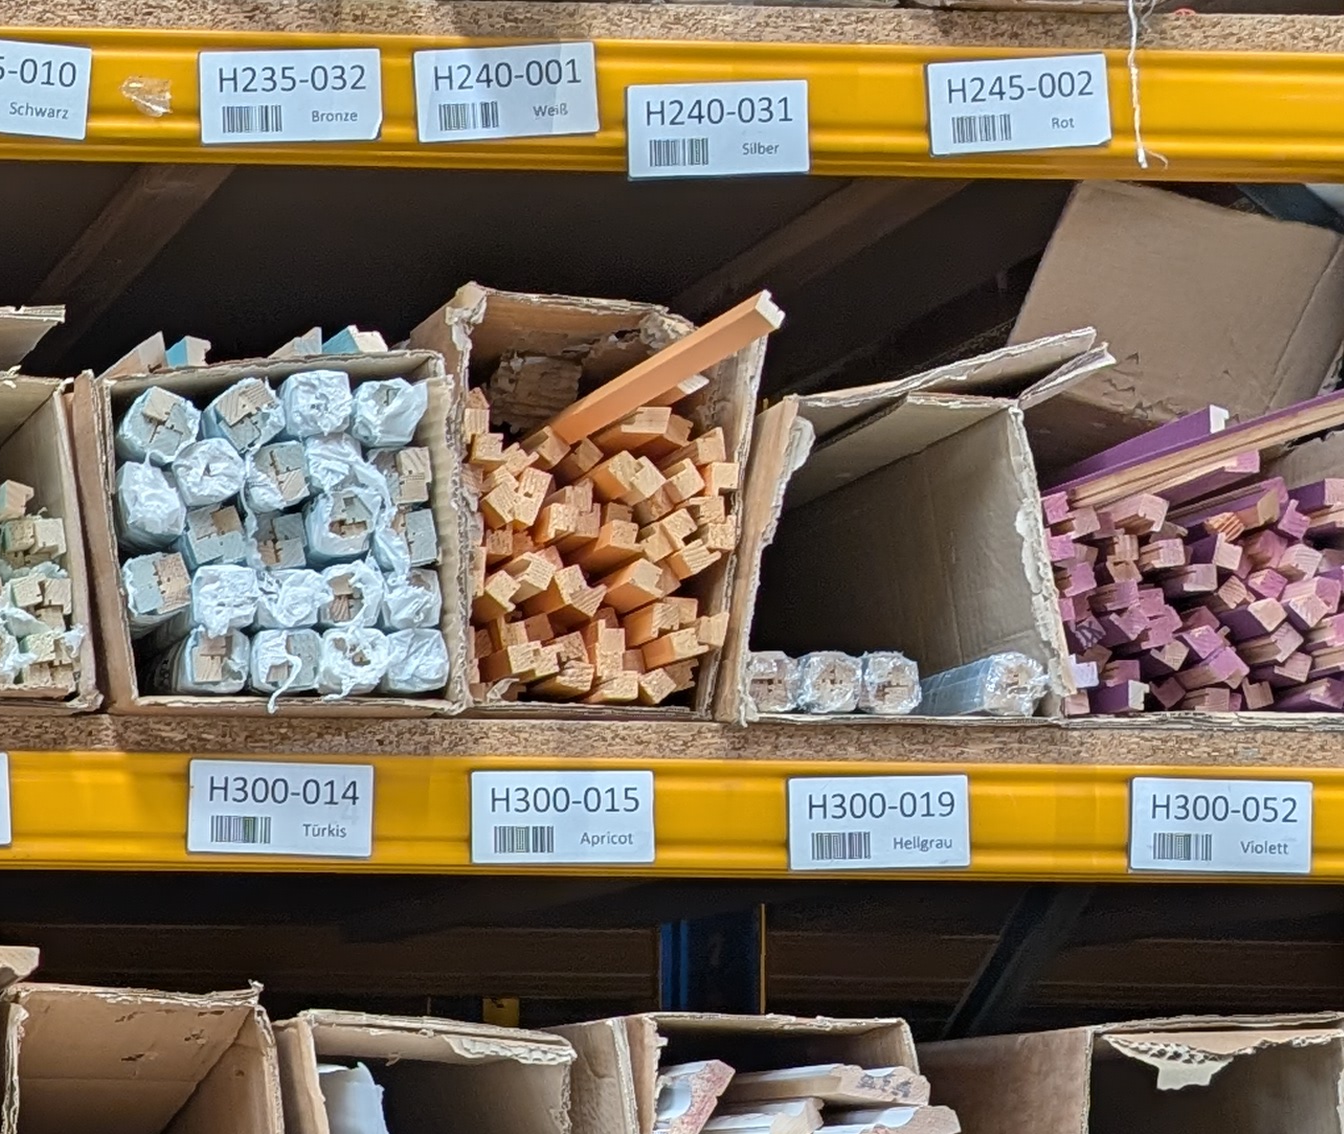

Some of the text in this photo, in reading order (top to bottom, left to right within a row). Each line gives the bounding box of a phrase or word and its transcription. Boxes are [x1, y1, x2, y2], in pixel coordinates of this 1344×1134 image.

[218, 64, 367, 93] H235-032
[433, 58, 582, 91] H240-001
[947, 70, 1094, 104] H245-002
[8, 101, 69, 120] Schwarz
[311, 110, 358, 123] Bronze
[532, 102, 569, 118] Weiß
[646, 96, 793, 127] H240-031
[1051, 116, 1075, 130] Rot
[742, 141, 780, 156] Silber
[209, 775, 360, 806] H300-014
[491, 786, 640, 813] H300-015
[808, 791, 955, 820] H300-019
[1151, 793, 1298, 823] H300-052
[302, 823, 347, 839] Türkis
[579, 830, 634, 848] Apricot
[893, 835, 953, 853] Hellgrau
[1240, 840, 1289, 855] Violett
